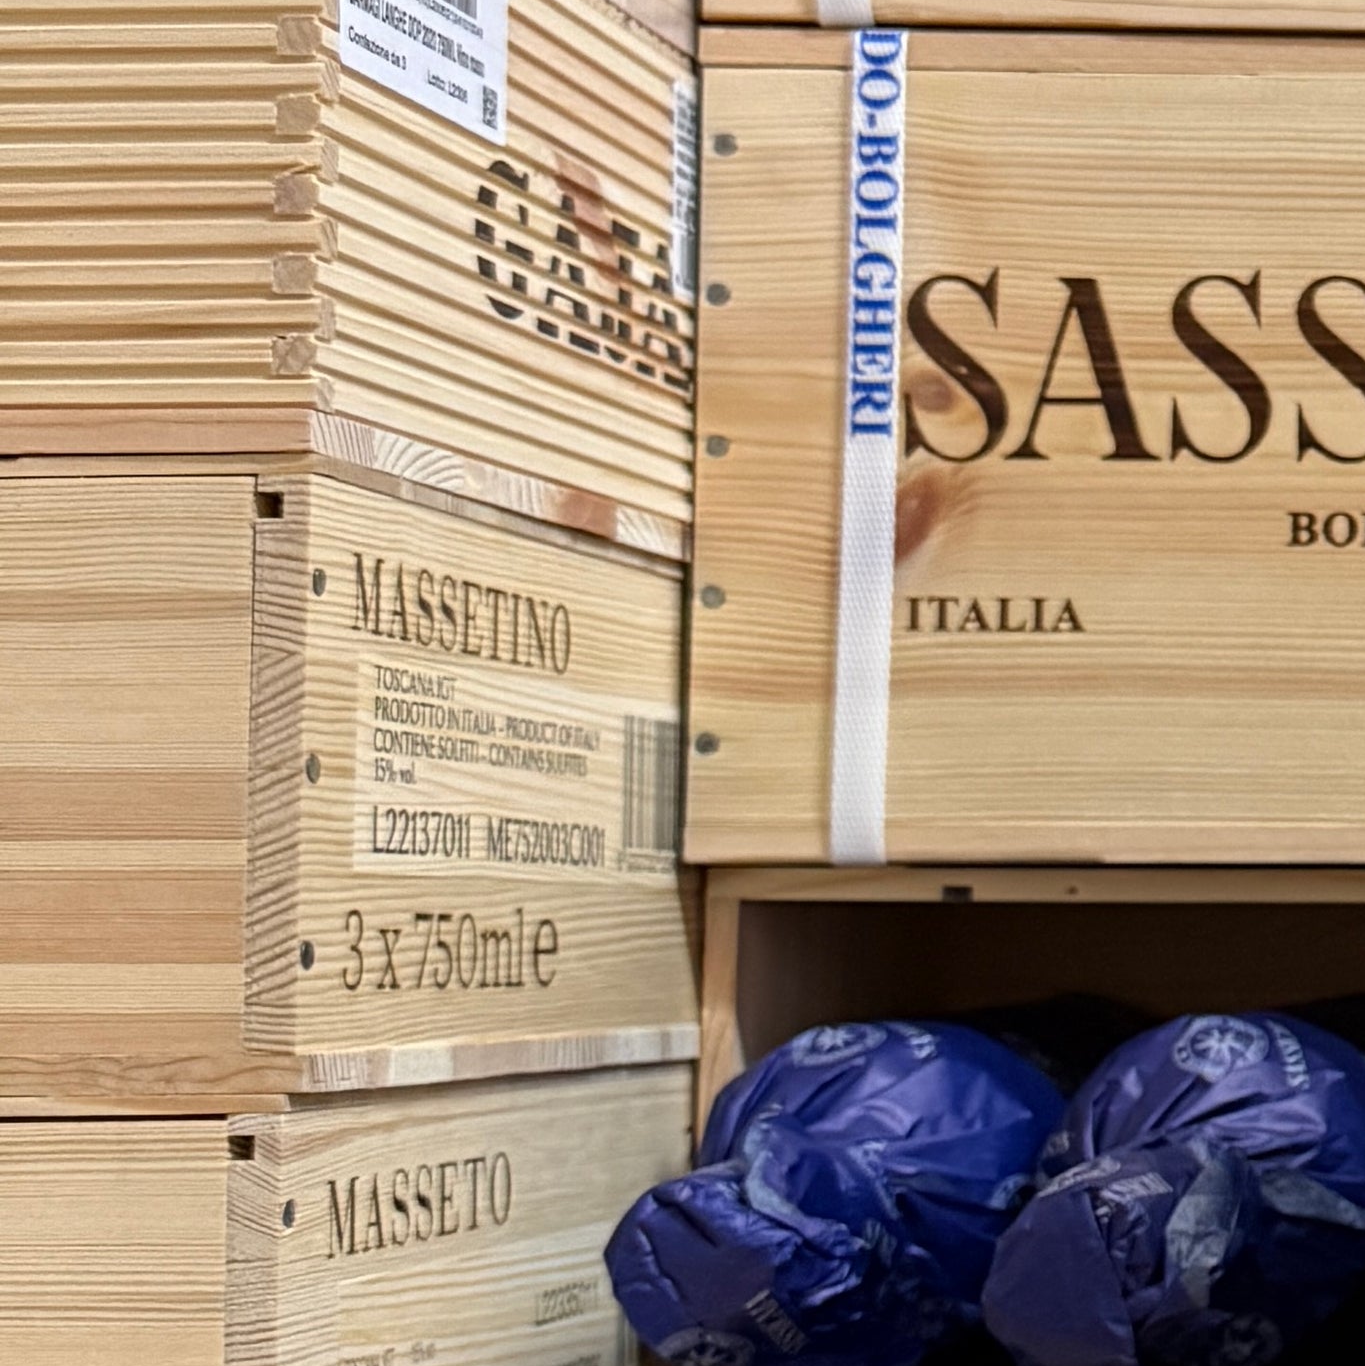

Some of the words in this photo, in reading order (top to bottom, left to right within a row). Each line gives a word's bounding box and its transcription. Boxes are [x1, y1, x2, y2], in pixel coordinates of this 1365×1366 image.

[351, 552, 572, 676] MASSETINO
[905, 594, 1086, 634] ITALIA
[374, 664, 436, 699] TOSCANA
[374, 695, 445, 730] PRODOTTO
[374, 730, 436, 760] CONTIENE
[372, 805, 471, 858] L22137011
[343, 908, 365, 992] 3
[378, 927, 402, 990] x
[326, 1151, 513, 1260] MASSETO
